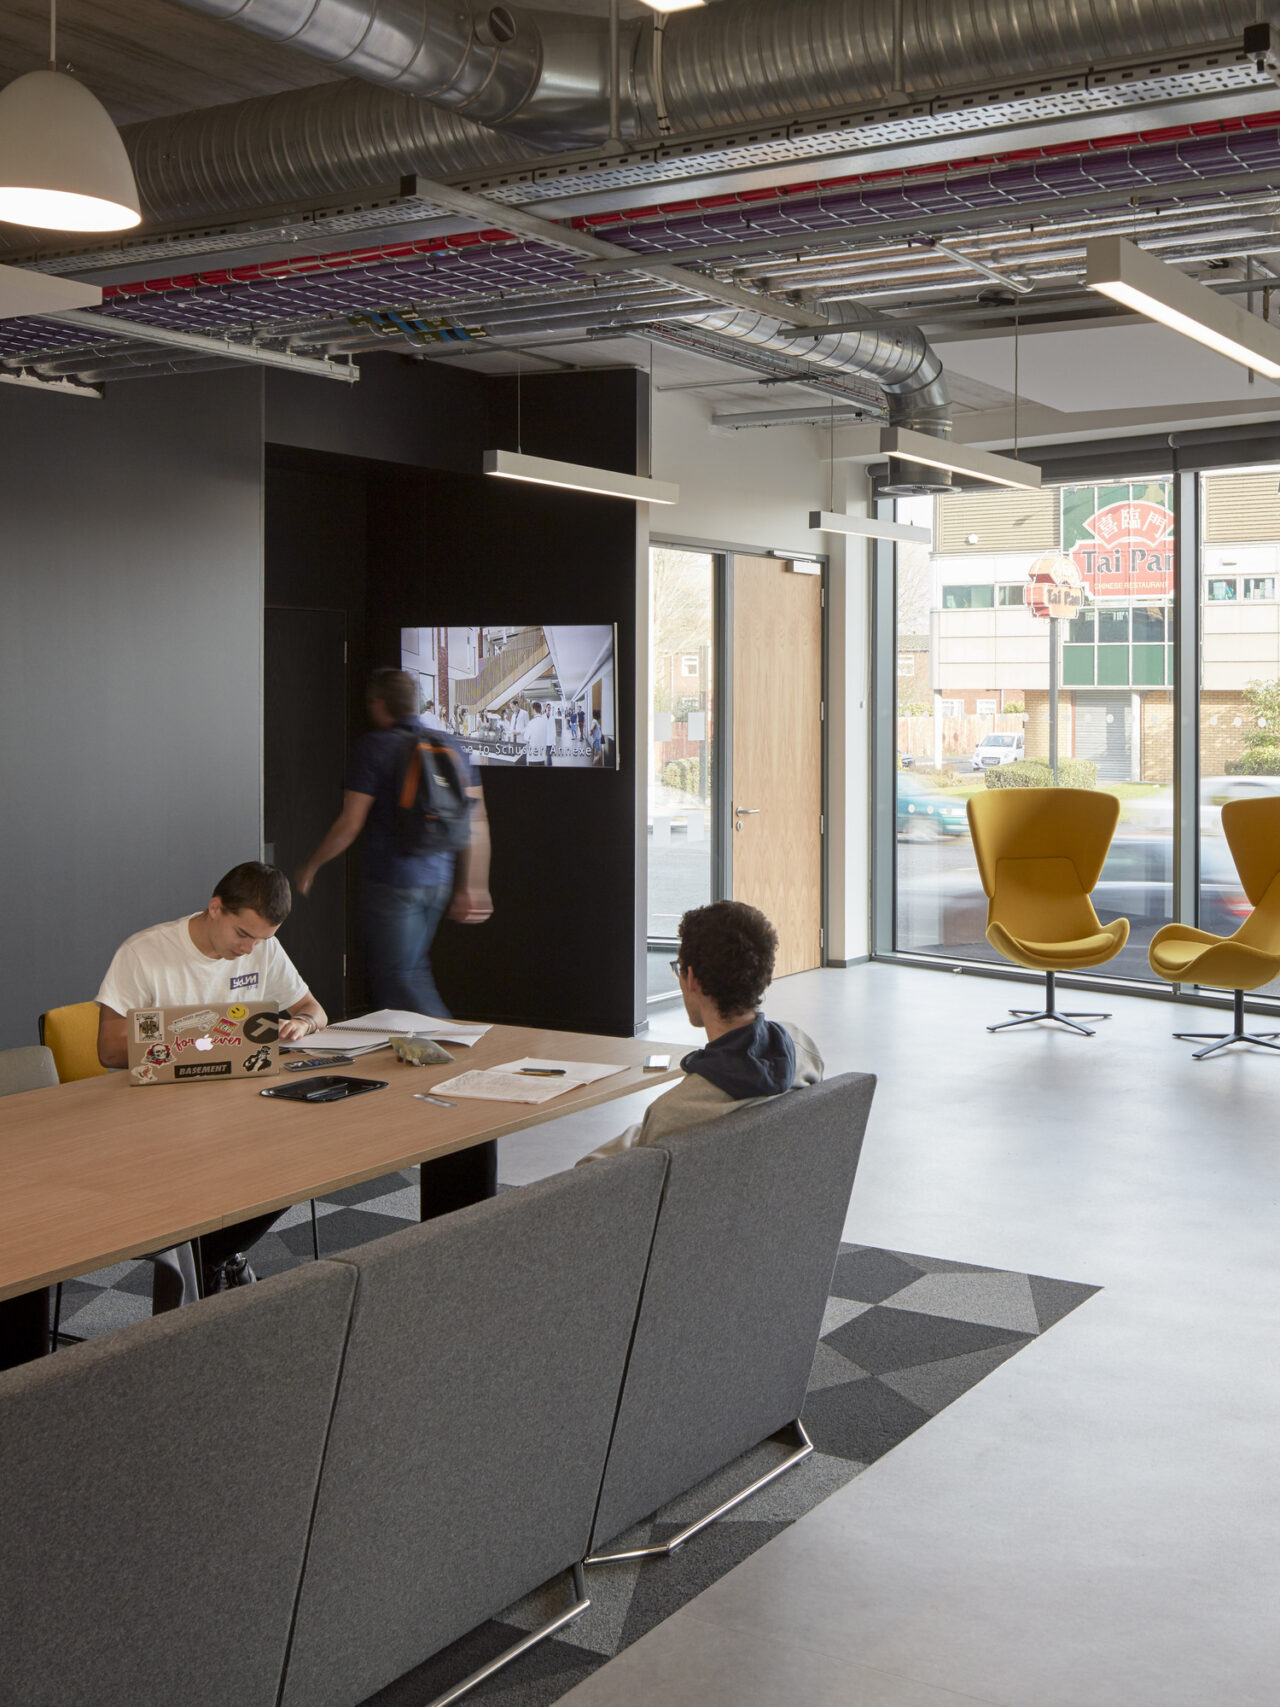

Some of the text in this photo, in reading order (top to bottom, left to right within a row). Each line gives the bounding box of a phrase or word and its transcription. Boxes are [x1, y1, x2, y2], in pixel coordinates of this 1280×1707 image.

[1097, 508, 1168, 539] 喜臨門
[1082, 549, 1121, 573] Tai
[1095, 581, 1168, 590] CHINESE RESTAURANT
[1047, 589, 1081, 606] Tai Pan
[495, 744, 545, 756] Schuster
[549, 745, 592, 757] Annexe
[179, 1064, 227, 1075] BASEMENT
